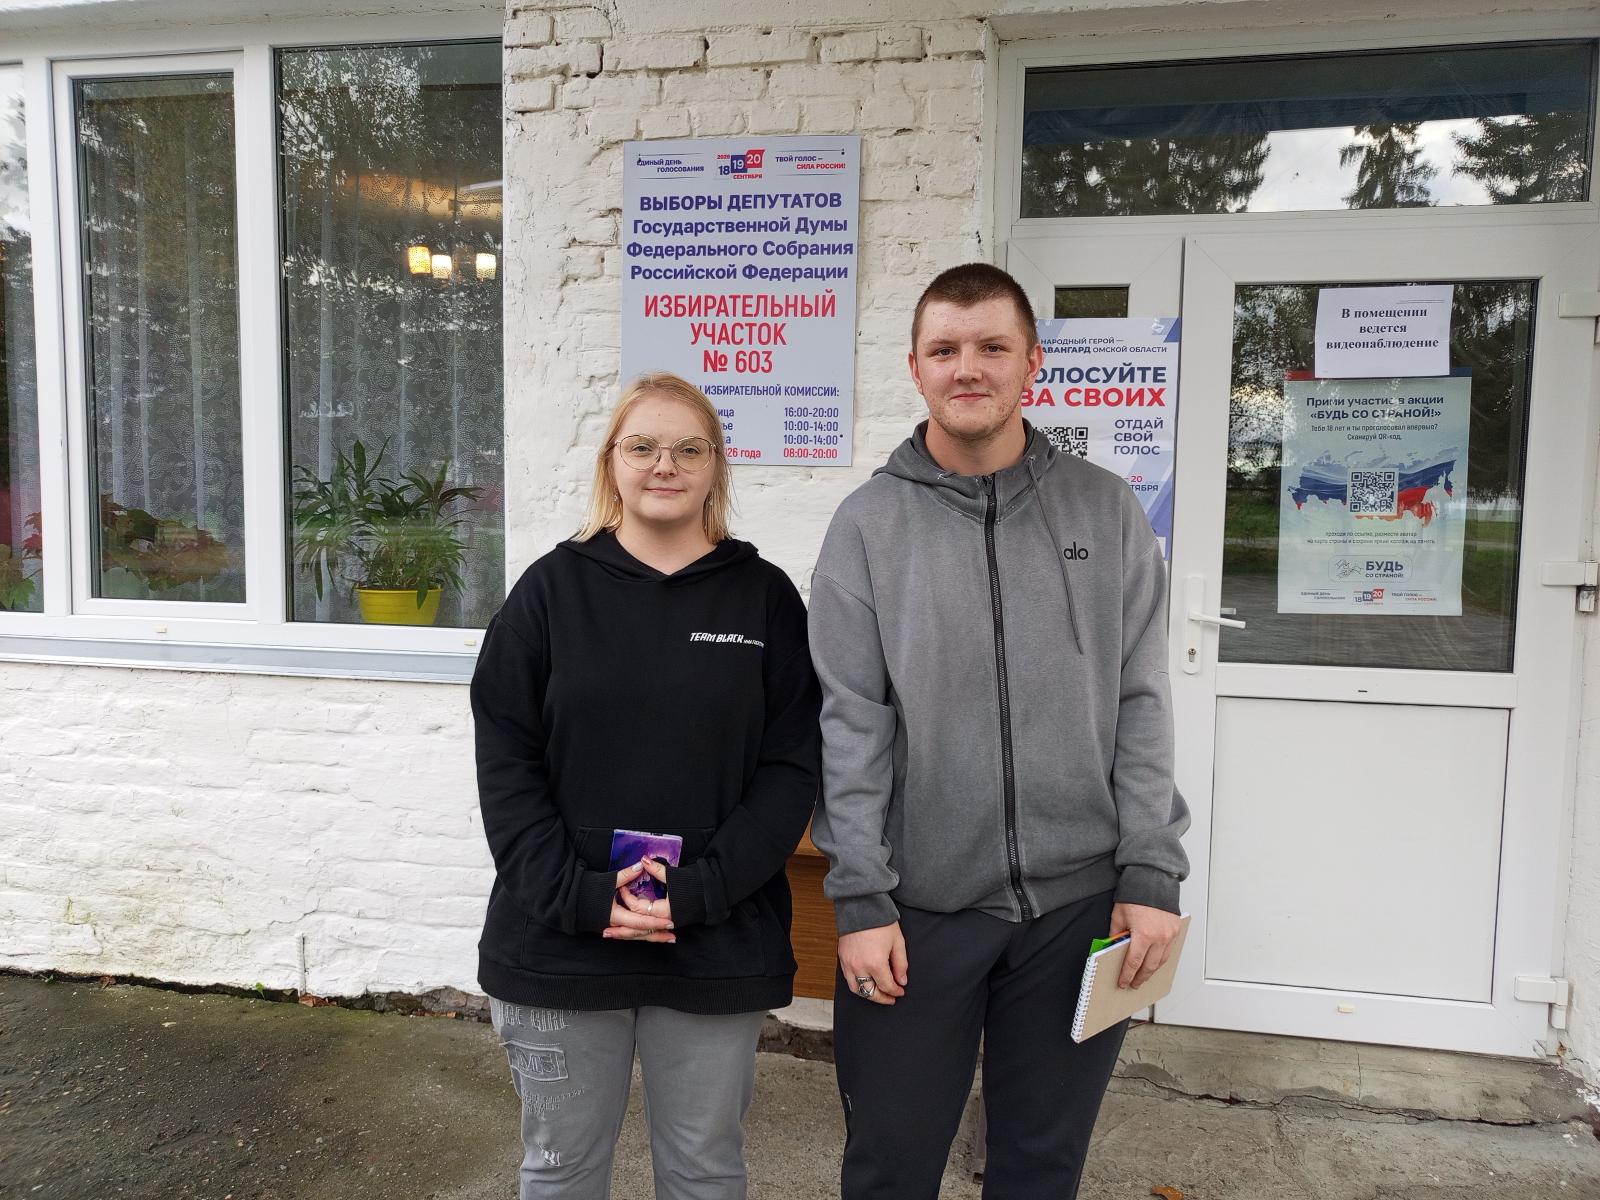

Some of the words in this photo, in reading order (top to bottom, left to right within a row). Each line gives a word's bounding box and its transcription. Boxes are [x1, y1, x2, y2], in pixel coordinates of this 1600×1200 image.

[718, 165, 731, 175] 18
[732, 159, 744, 170] 19
[746, 154, 761, 164] 20
[640, 195, 722, 211] ВЫБОРЫ
[727, 193, 842, 212] ДЕПУТАТОВ
[633, 216, 791, 238] Государственной
[794, 217, 848, 236] Думы
[626, 241, 758, 260] Федерального
[762, 240, 854, 259] Собрания
[631, 264, 737, 280] Российской
[742, 263, 848, 282] Федерации
[644, 288, 837, 318] ИЗБИРАТЕЛЬНЫЙ
[1341, 308, 1350, 319] В
[1354, 308, 1428, 319] помещении
[690, 322, 788, 346] УЧАСТОК
[1359, 324, 1407, 335] ведется
[1040, 336, 1087, 346] НАРОДНЫЙ
[1088, 336, 1115, 345] ГЕРОЙ
[1326, 338, 1439, 350] видеонаблюдение
[1092, 344, 1128, 353] ОМСКОЙ
[1129, 345, 1167, 353] ОБЛАСТИ
[703, 350, 728, 373] №
[735, 350, 773, 373] 603
[1035, 362, 1167, 384] ОЛОСУЙТЕ
[704, 383, 782, 397] ИЗБИРАТЕЛЬНОЙ
[784, 385, 840, 397] КОМИССИИ:
[1021, 387, 1056, 407] ЗА
[1063, 387, 1167, 407] СВОИХ
[1306, 397, 1345, 408] Прими
[1347, 396, 1395, 408] участие
[1407, 396, 1444, 406] акции
[784, 407, 839, 418] 16:00-20:00
[1310, 410, 1349, 420] «БУДЬ
[1351, 409, 1369, 419] СО
[784, 420, 839, 432] 10:00-14:00
[1114, 416, 1164, 431] ОТДАЙ
[783, 434, 838, 445] 10:00-14:00
[1113, 430, 1153, 442] СВОЙ
[1347, 433, 1377, 441] Сканируй
[726, 447, 738, 458] 26
[740, 450, 762, 459] года
[783, 447, 838, 459] 08:00-20:00
[1113, 445, 1161, 455] ГОЛОС
[1131, 475, 1143, 483] 20
[1130, 484, 1159, 492] ТЯБРЯ
[1063, 541, 1089, 560] alo
[1365, 560, 1404, 572] БУДЬ
[1372, 590, 1383, 598] 20
[690, 632, 717, 642] TEAM
[716, 633, 744, 643] BLACK
